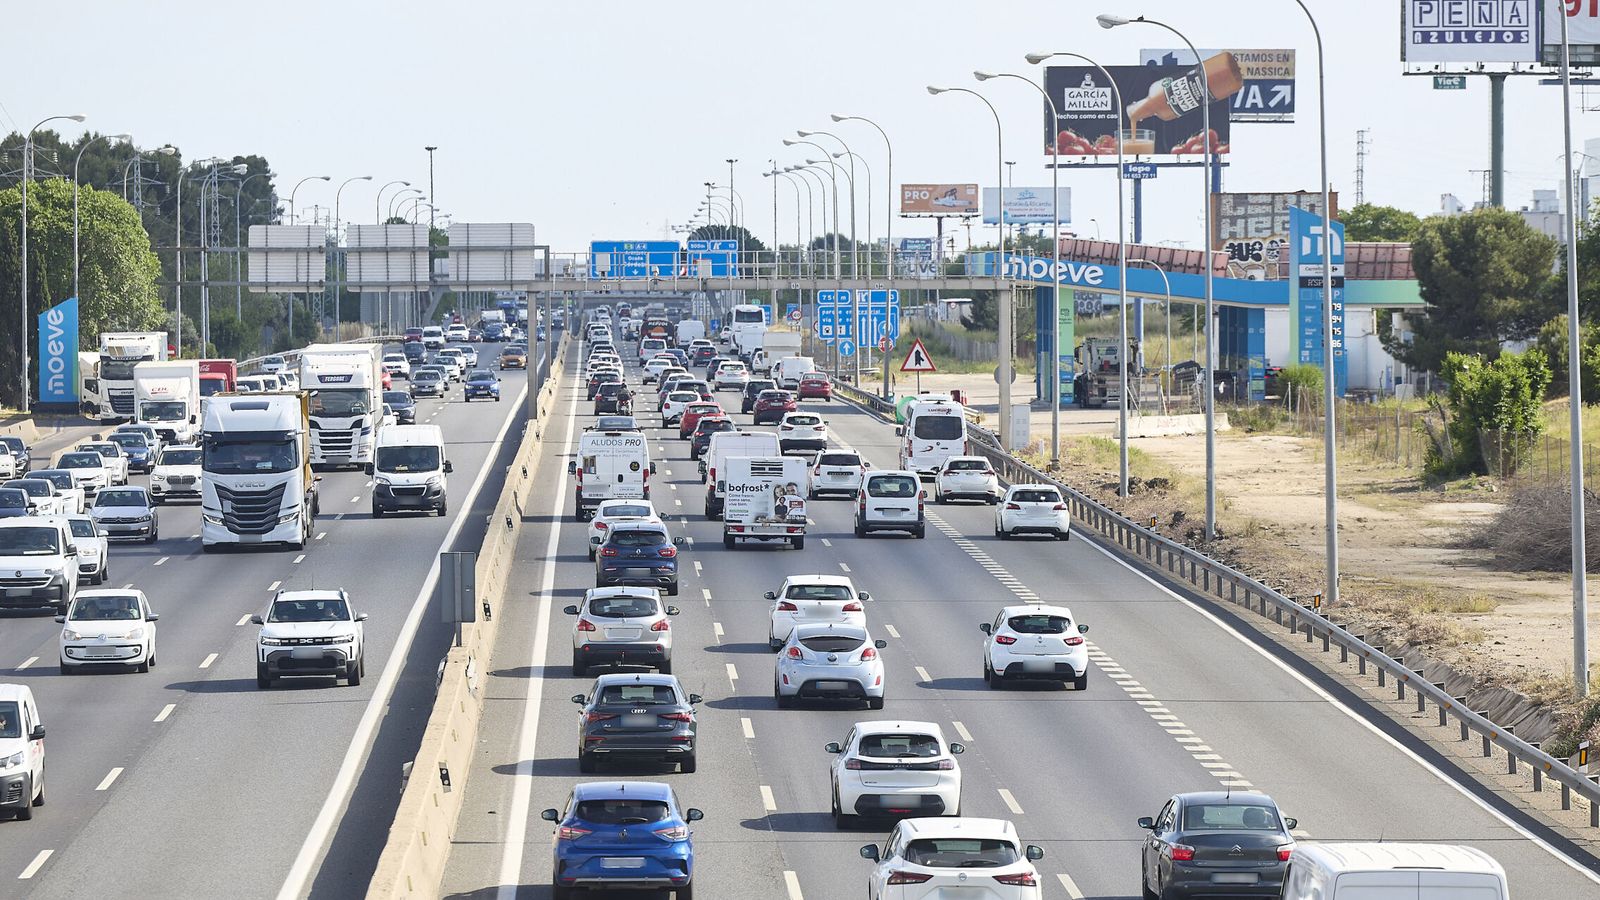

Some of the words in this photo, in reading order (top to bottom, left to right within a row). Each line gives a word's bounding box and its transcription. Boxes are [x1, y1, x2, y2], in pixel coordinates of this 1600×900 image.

[1414, 31, 1528, 43] AZULEJOS
[1233, 53, 1274, 63] STAMOS
[1276, 53, 1290, 63] EN
[1246, 66, 1290, 77] NASSICA
[904, 190, 930, 200] PRO
[1003, 256, 1104, 285] moeve
[46, 308, 65, 395] moeve
[591, 439, 623, 447] ALUDOS
[625, 438, 642, 447] PRO
